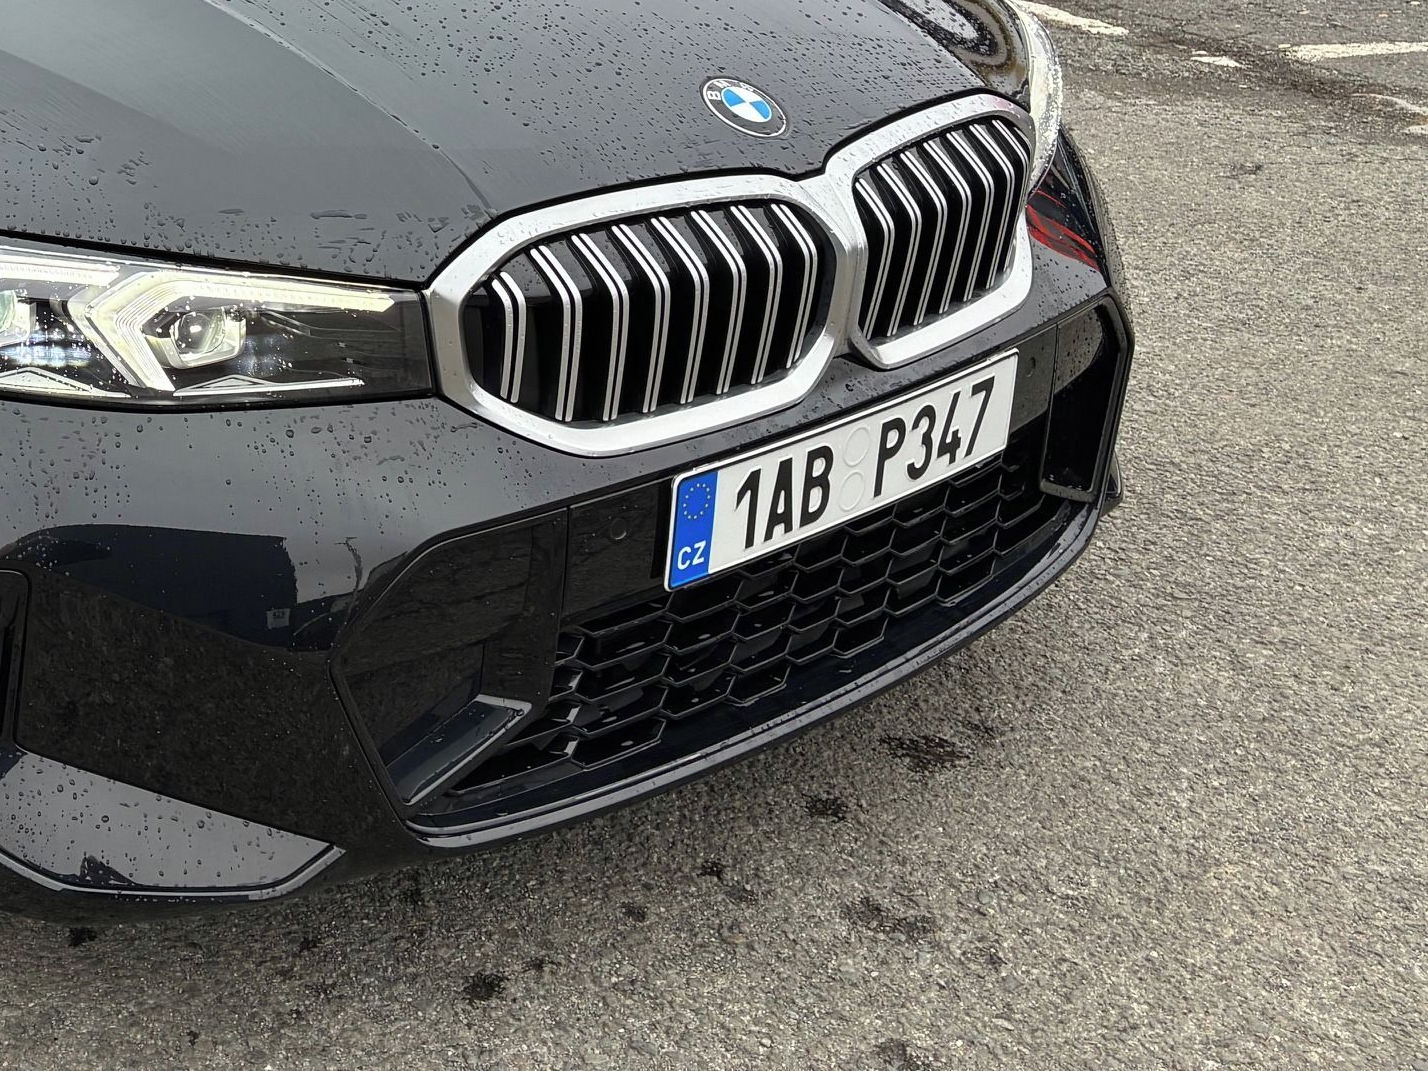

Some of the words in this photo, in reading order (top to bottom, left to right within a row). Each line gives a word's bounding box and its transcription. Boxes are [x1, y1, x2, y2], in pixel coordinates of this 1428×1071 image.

[736, 443, 834, 550] 1AB
[873, 375, 996, 498] P347
[677, 539, 706, 571] CZ
